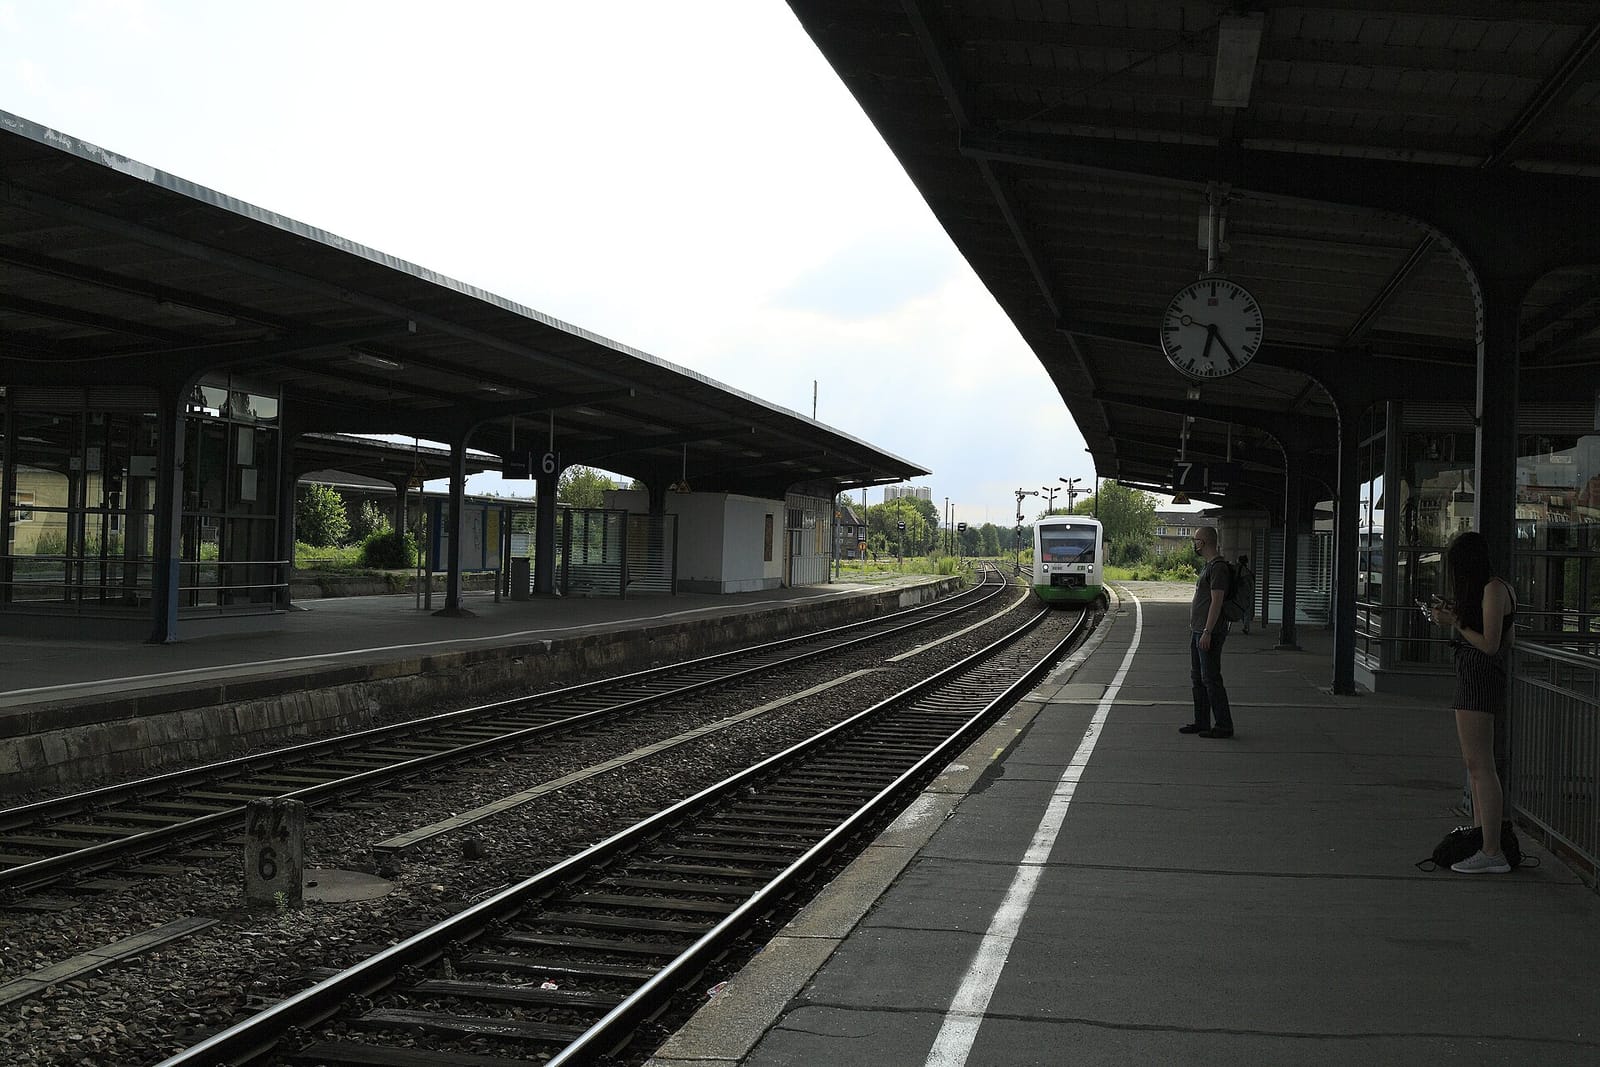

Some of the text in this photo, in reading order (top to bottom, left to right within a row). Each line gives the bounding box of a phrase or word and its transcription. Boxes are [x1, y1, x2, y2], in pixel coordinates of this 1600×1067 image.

[542, 453, 555, 474] 6
[1177, 463, 1193, 485] 7
[258, 846, 278, 881] 6
